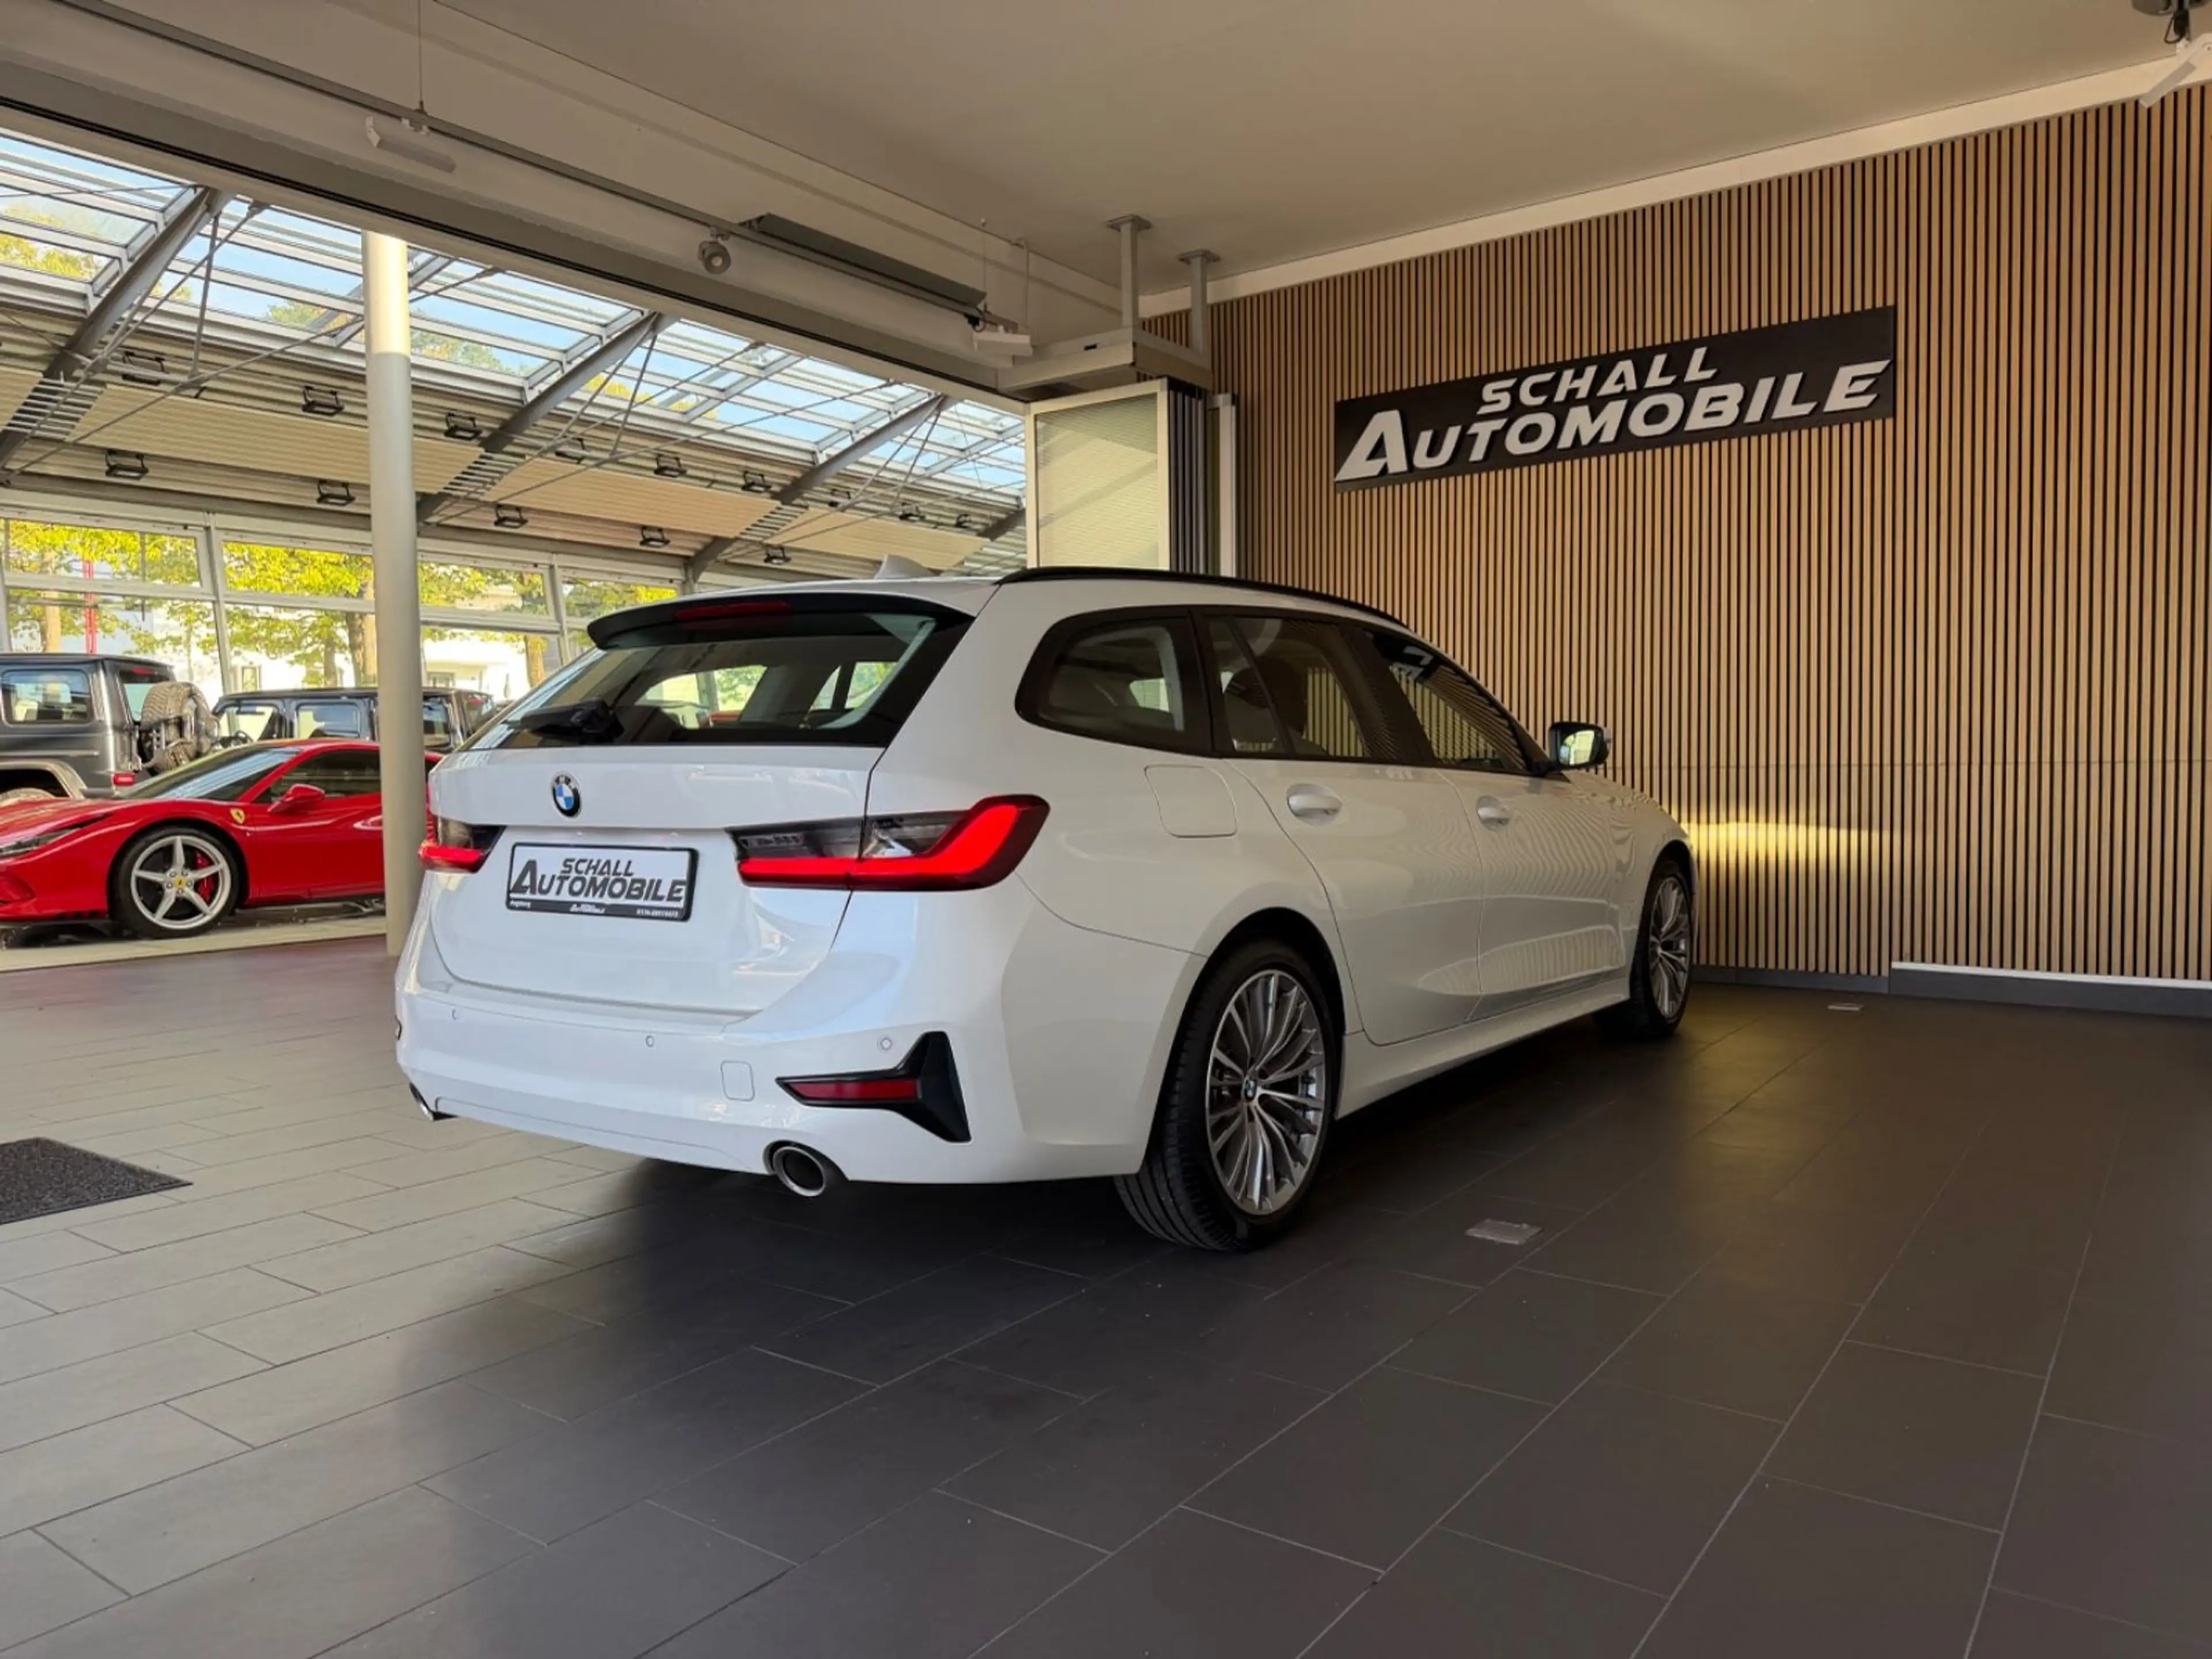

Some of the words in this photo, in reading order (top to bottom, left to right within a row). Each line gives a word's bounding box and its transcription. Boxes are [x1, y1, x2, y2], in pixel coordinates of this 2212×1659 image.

[1476, 346, 1717, 415] SCHALL
[1334, 359, 1891, 480] AUTOMOBILE
[510, 859, 687, 902] AUTOMOBILE
[561, 857, 634, 877] SCHALL
